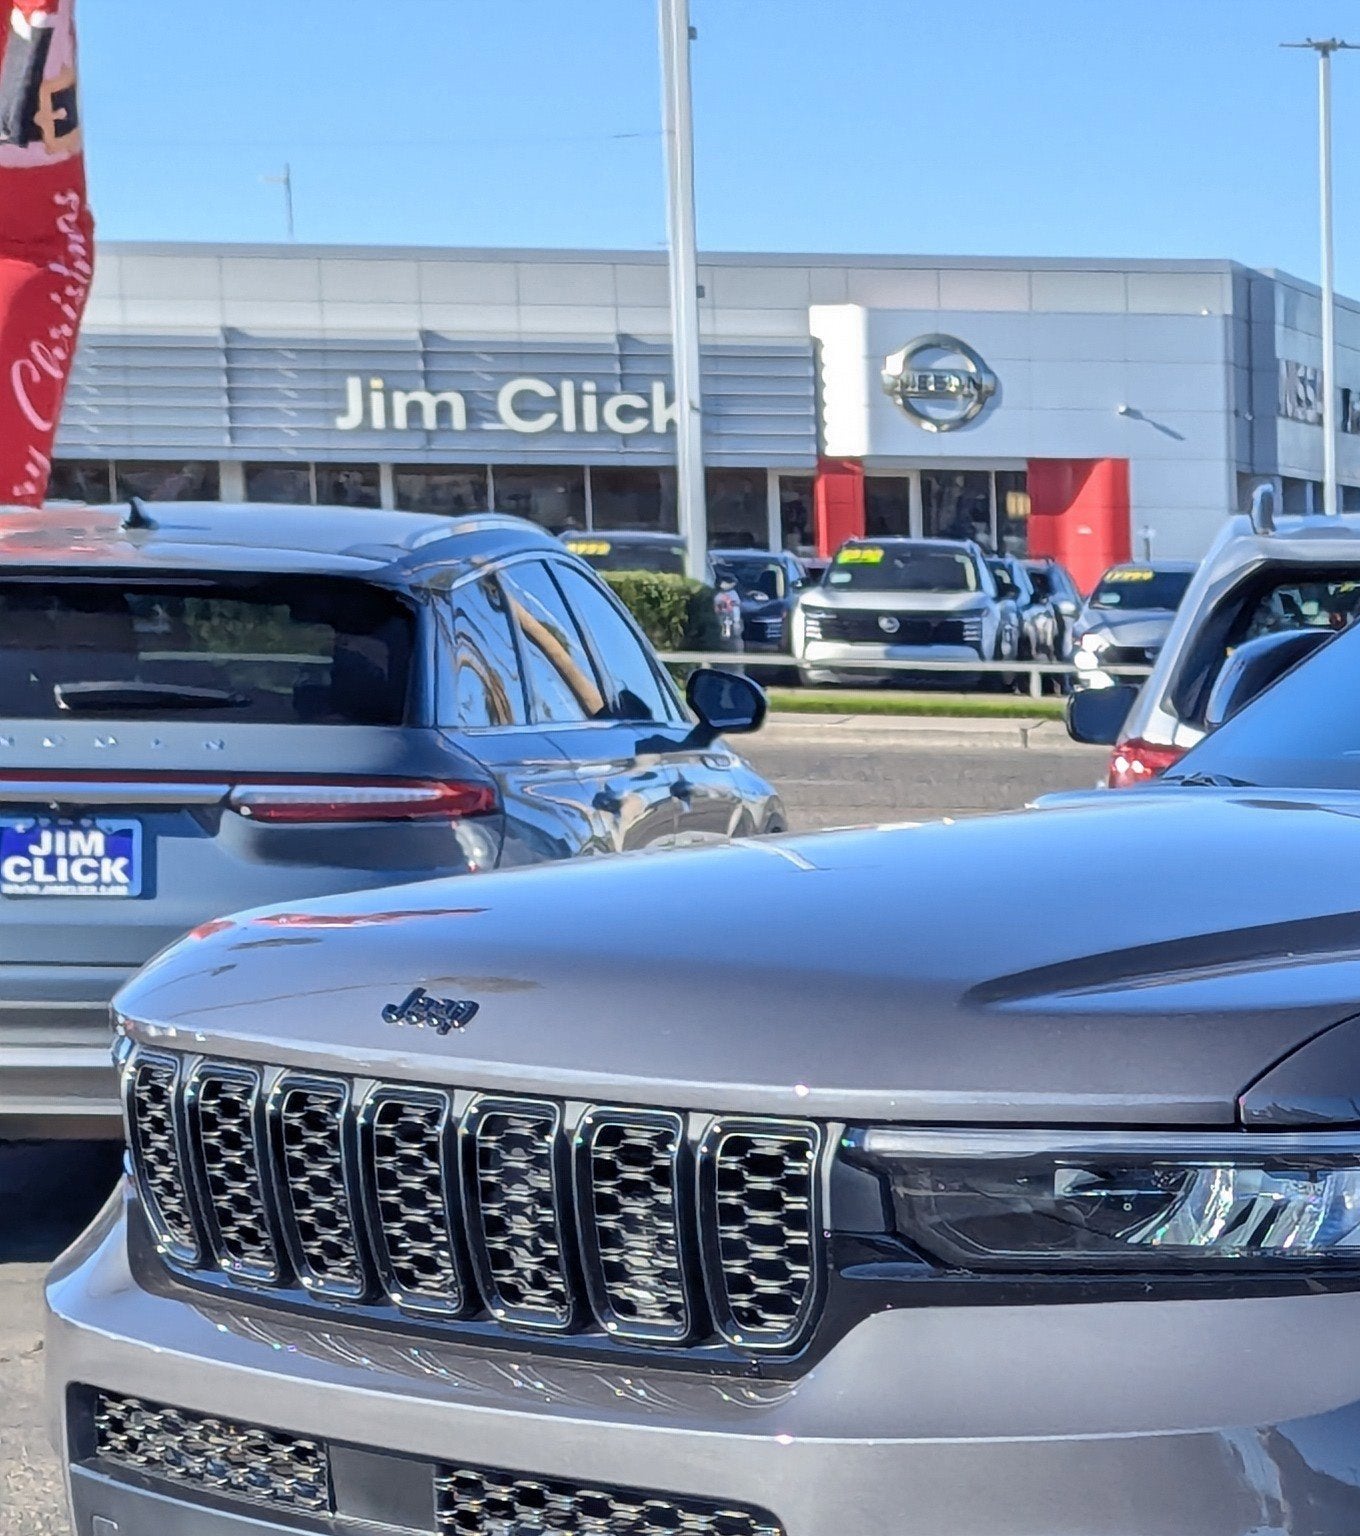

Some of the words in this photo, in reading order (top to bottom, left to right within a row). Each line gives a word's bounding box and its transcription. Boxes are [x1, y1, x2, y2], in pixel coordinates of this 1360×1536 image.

[11, 188, 88, 431] Christmas
[335, 376, 467, 430] Jim
[497, 377, 679, 434] Click
[28, 829, 105, 857] JIM
[1, 855, 130, 884] CLICK
[381, 986, 480, 1036] Jeep
